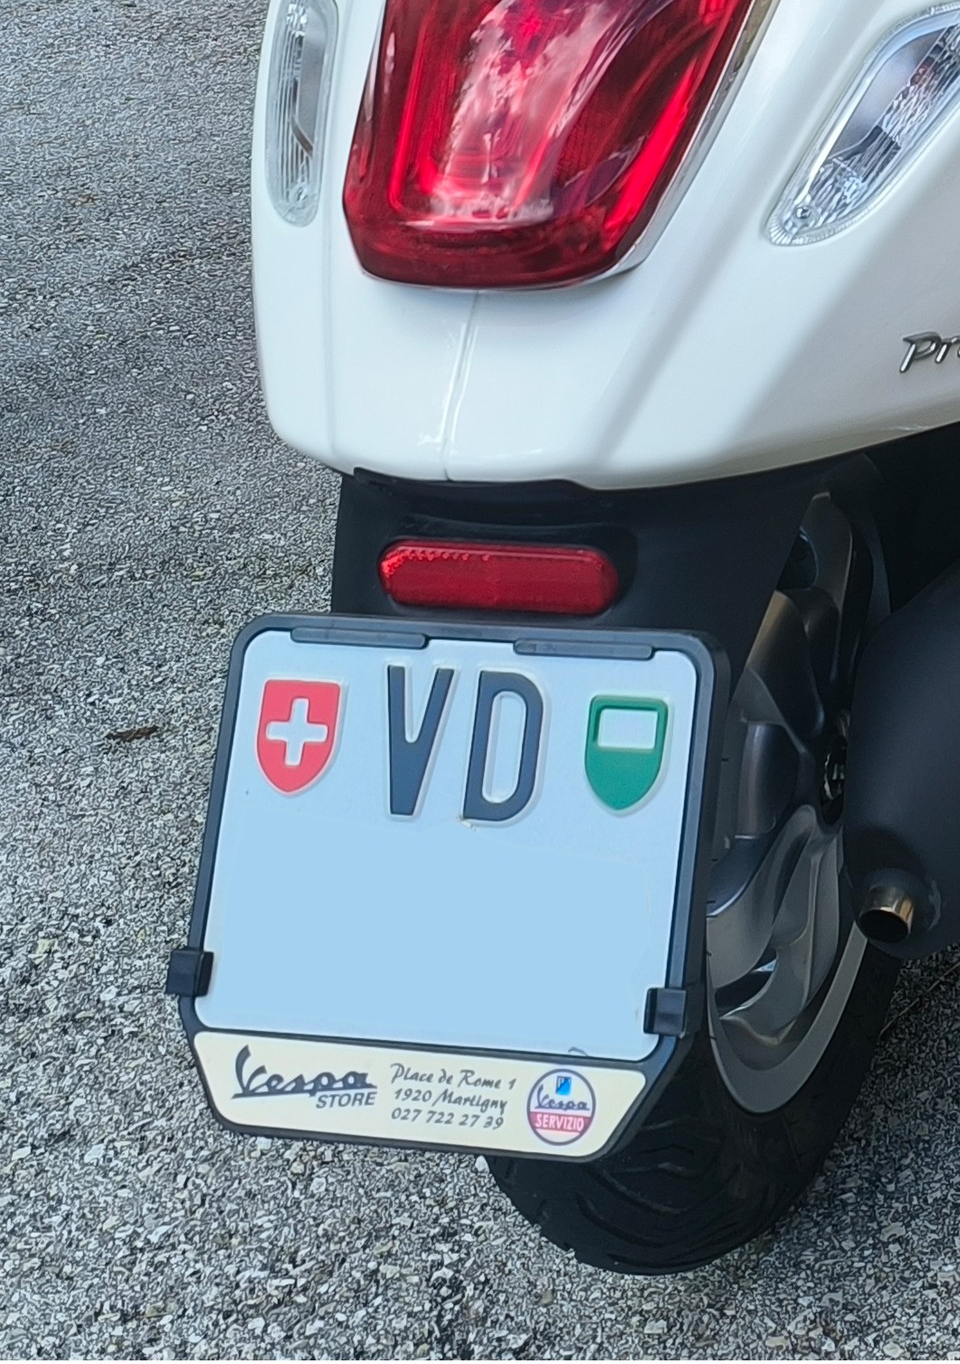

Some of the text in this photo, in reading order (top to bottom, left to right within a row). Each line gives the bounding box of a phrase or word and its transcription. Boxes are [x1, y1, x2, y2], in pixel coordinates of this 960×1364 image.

[387, 664, 543, 822] VD
[230, 1044, 379, 1100] Vespa
[390, 1062, 517, 1090] Place de Rome 1
[315, 1091, 378, 1109] STORE
[394, 1088, 508, 1116] 1920 Martigny
[534, 1083, 591, 1112] Vespa
[391, 1107, 505, 1130] 027 722 27 39
[534, 1113, 585, 1132] SERVIZIO
